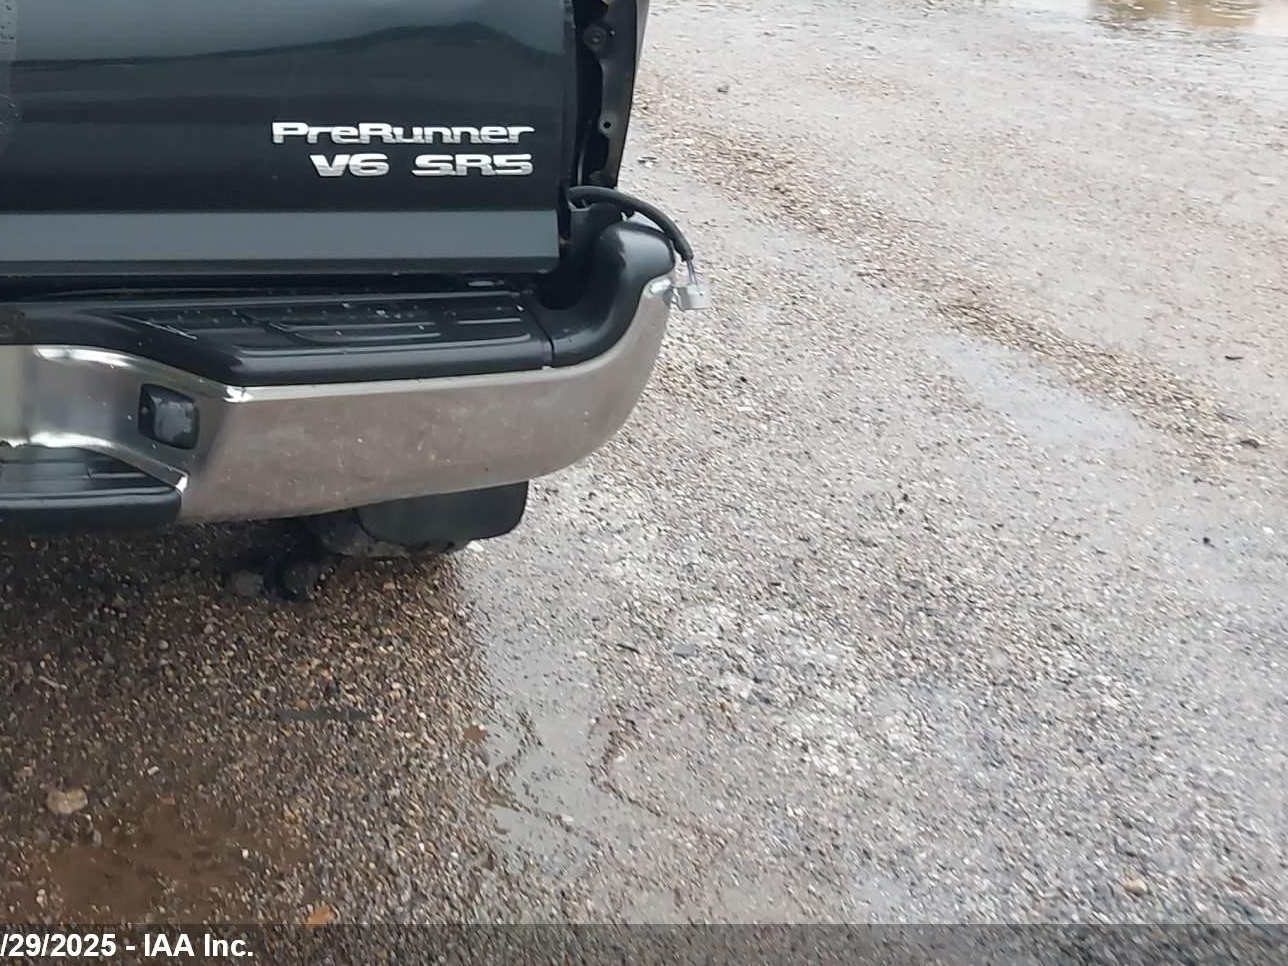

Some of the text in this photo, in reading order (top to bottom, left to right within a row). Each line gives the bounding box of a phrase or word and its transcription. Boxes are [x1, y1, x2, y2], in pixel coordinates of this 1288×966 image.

[271, 121, 536, 145] PreRunner
[309, 153, 533, 177] V6 SR5
